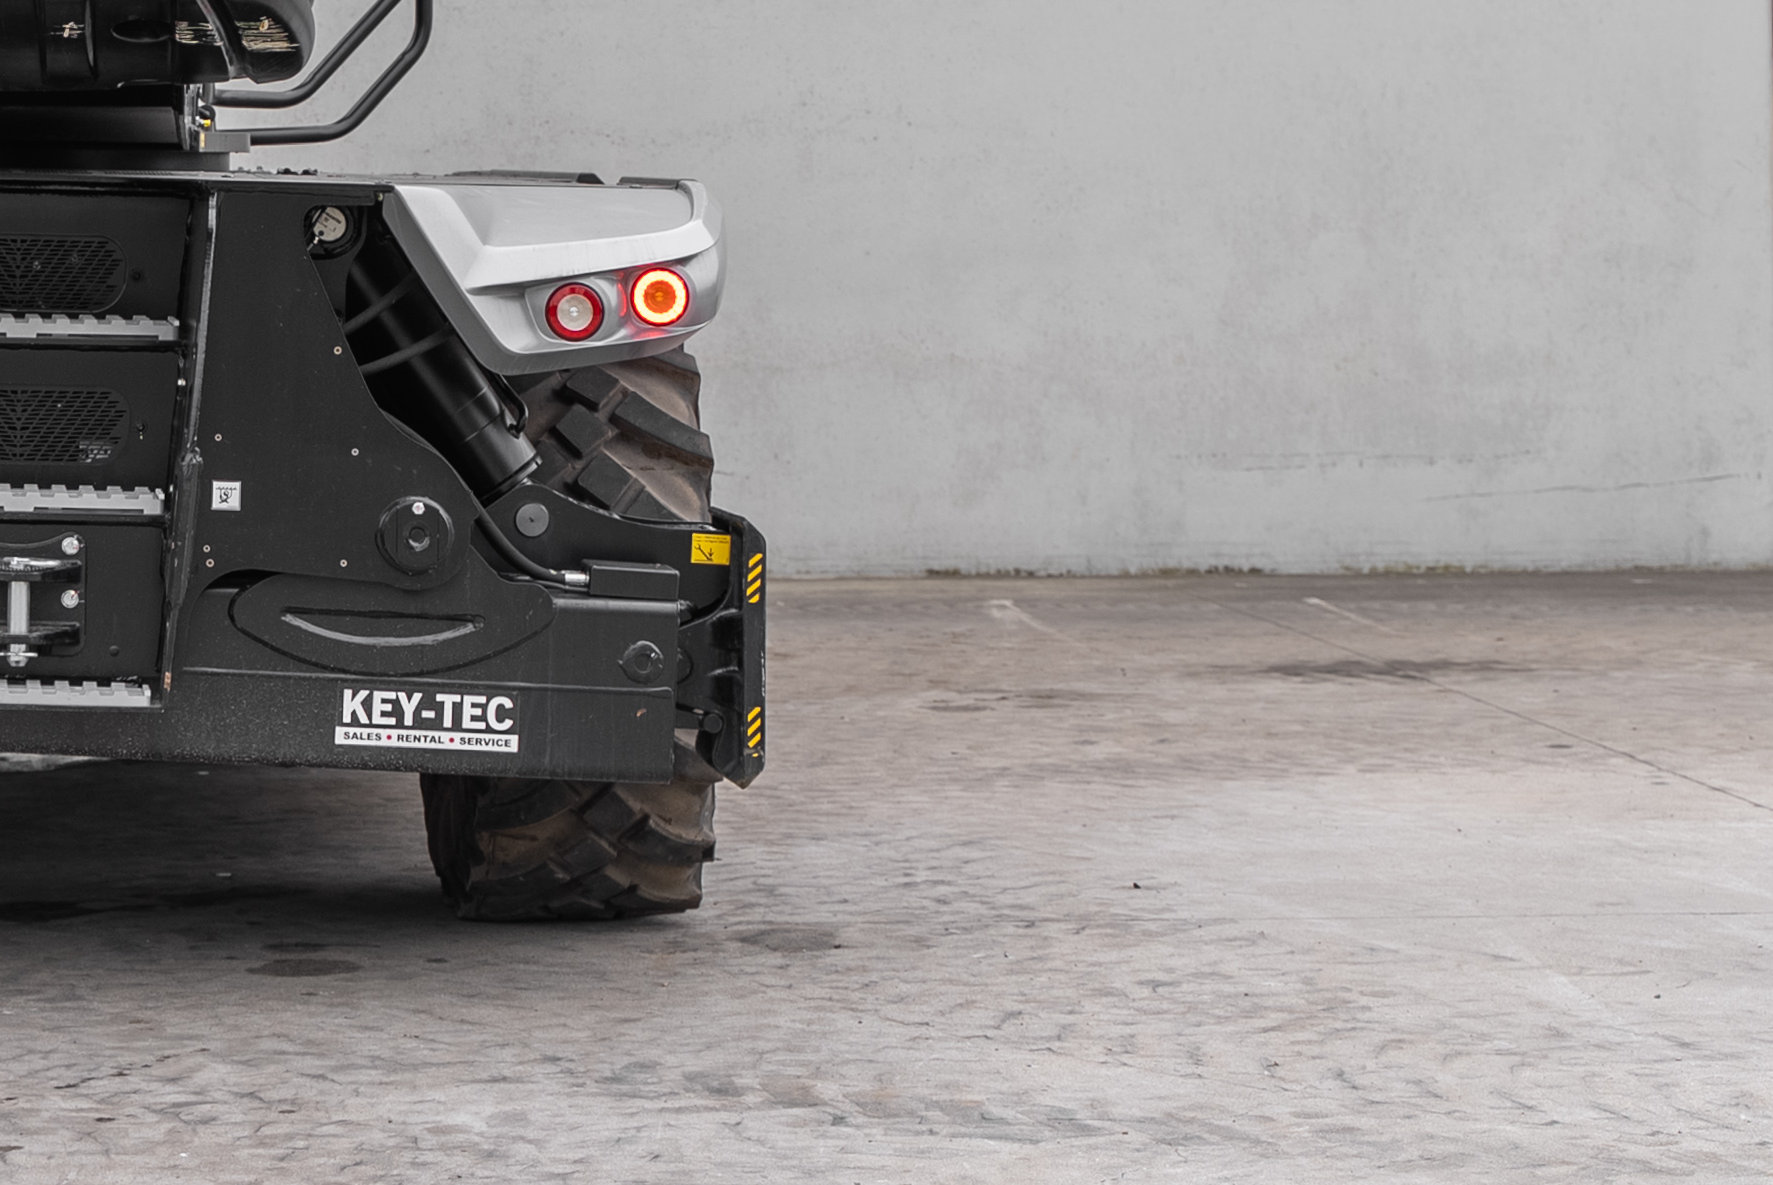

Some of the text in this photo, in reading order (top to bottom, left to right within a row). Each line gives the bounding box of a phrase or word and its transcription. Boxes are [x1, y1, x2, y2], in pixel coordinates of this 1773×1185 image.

[342, 688, 514, 731] KEY-TEC
[343, 731, 512, 747] SALES RENTAL SERVICE
